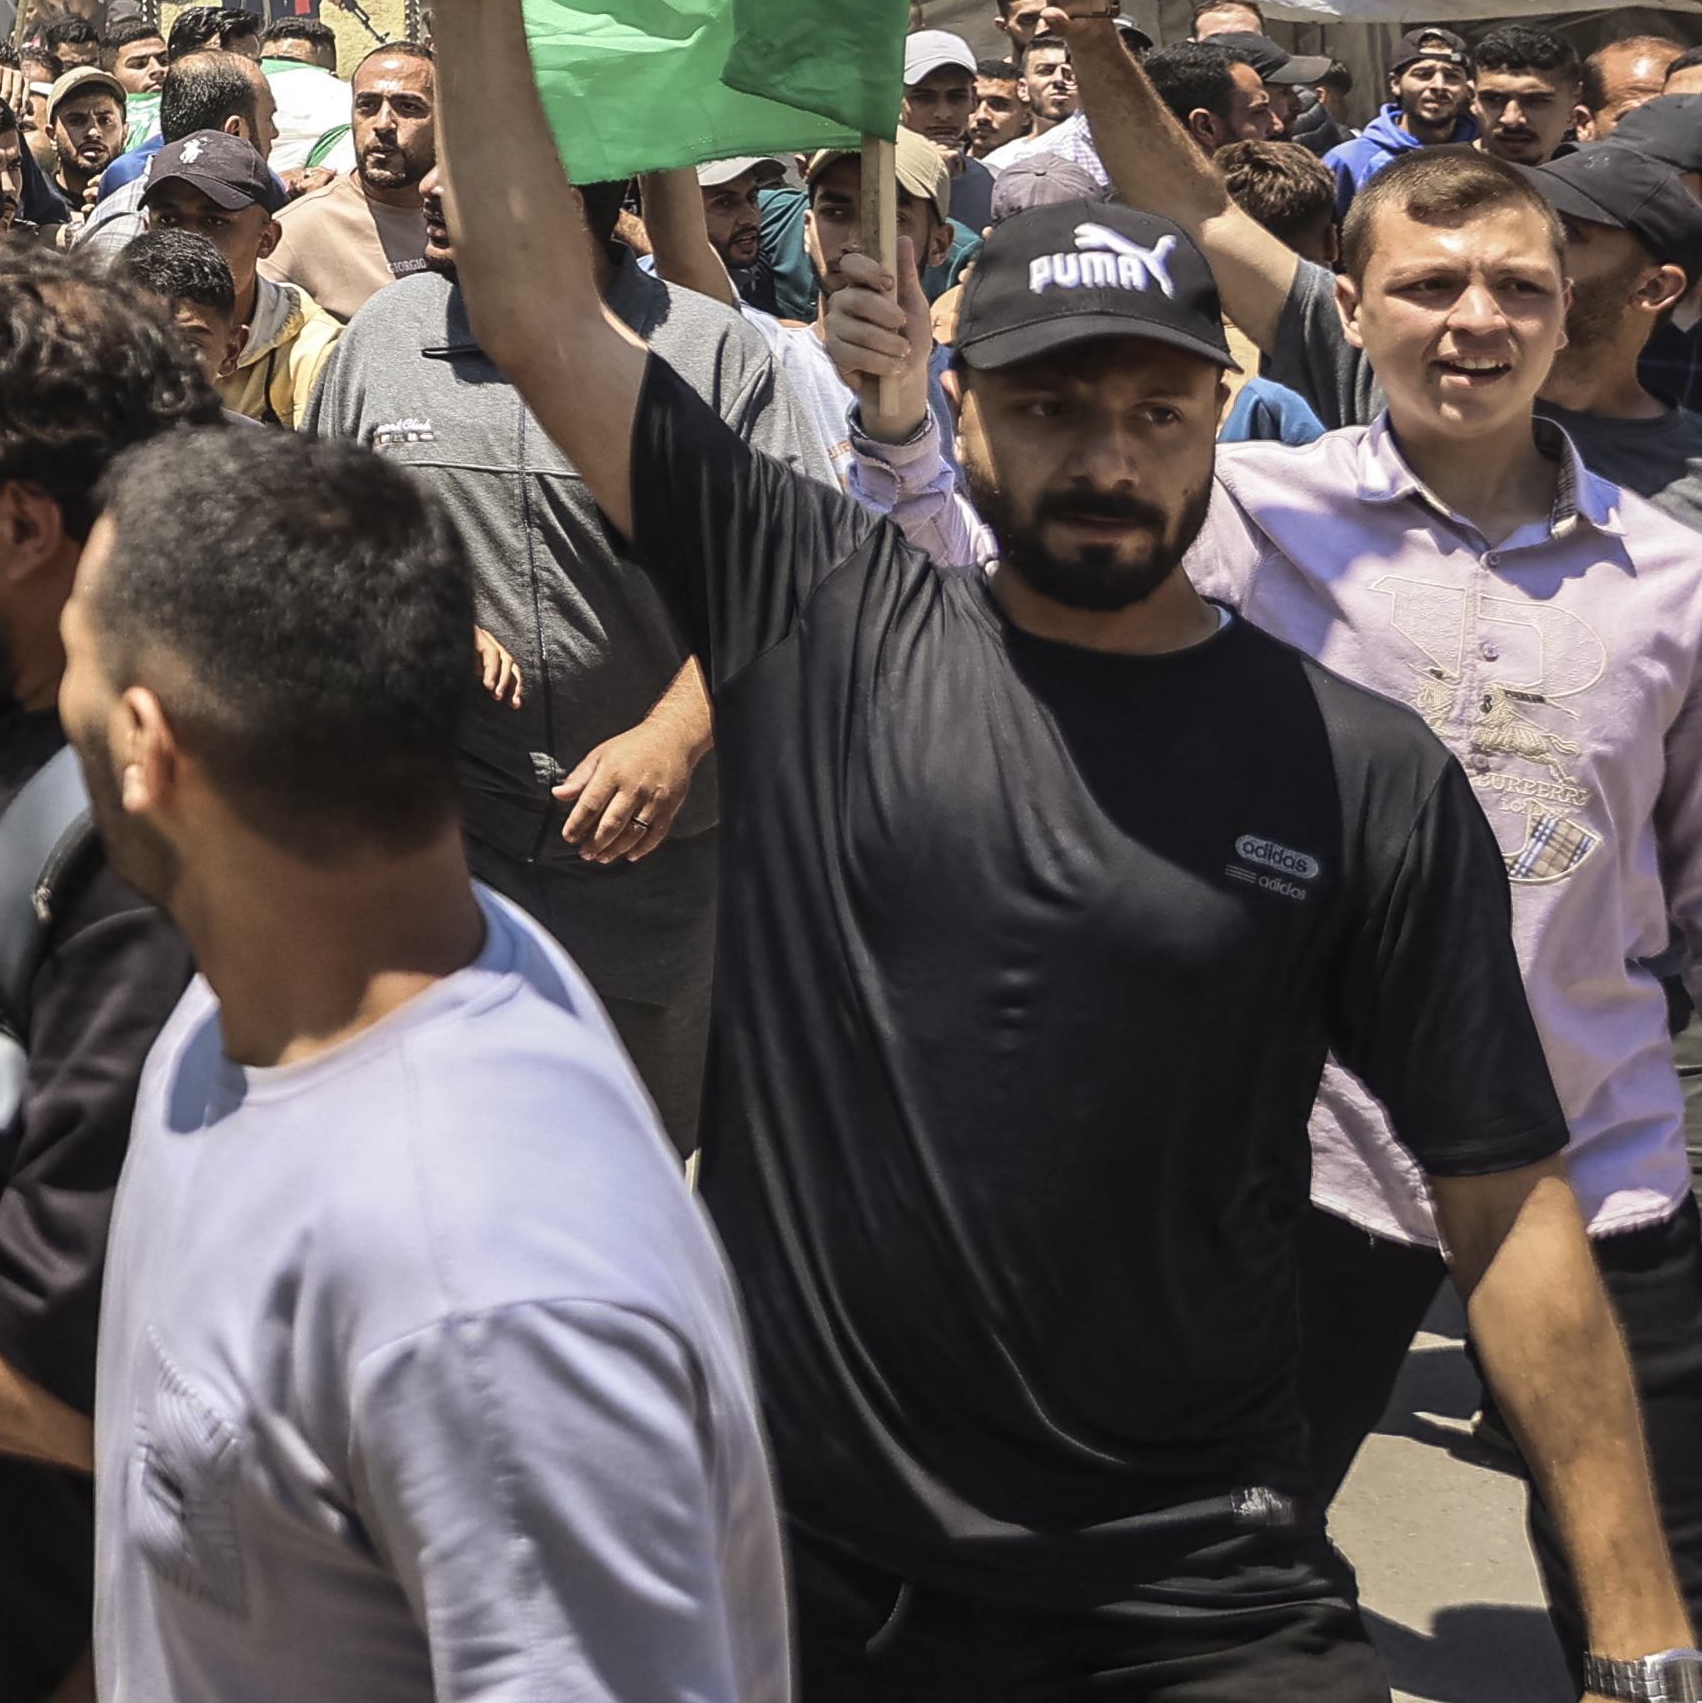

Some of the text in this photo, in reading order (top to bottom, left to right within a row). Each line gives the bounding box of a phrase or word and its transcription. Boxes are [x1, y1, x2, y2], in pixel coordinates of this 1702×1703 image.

[386, 257, 427, 274] GIORGIO
[1029, 251, 1147, 295] PUMA
[1241, 841, 1308, 874] adidas
[1257, 876, 1306, 900] adidas
